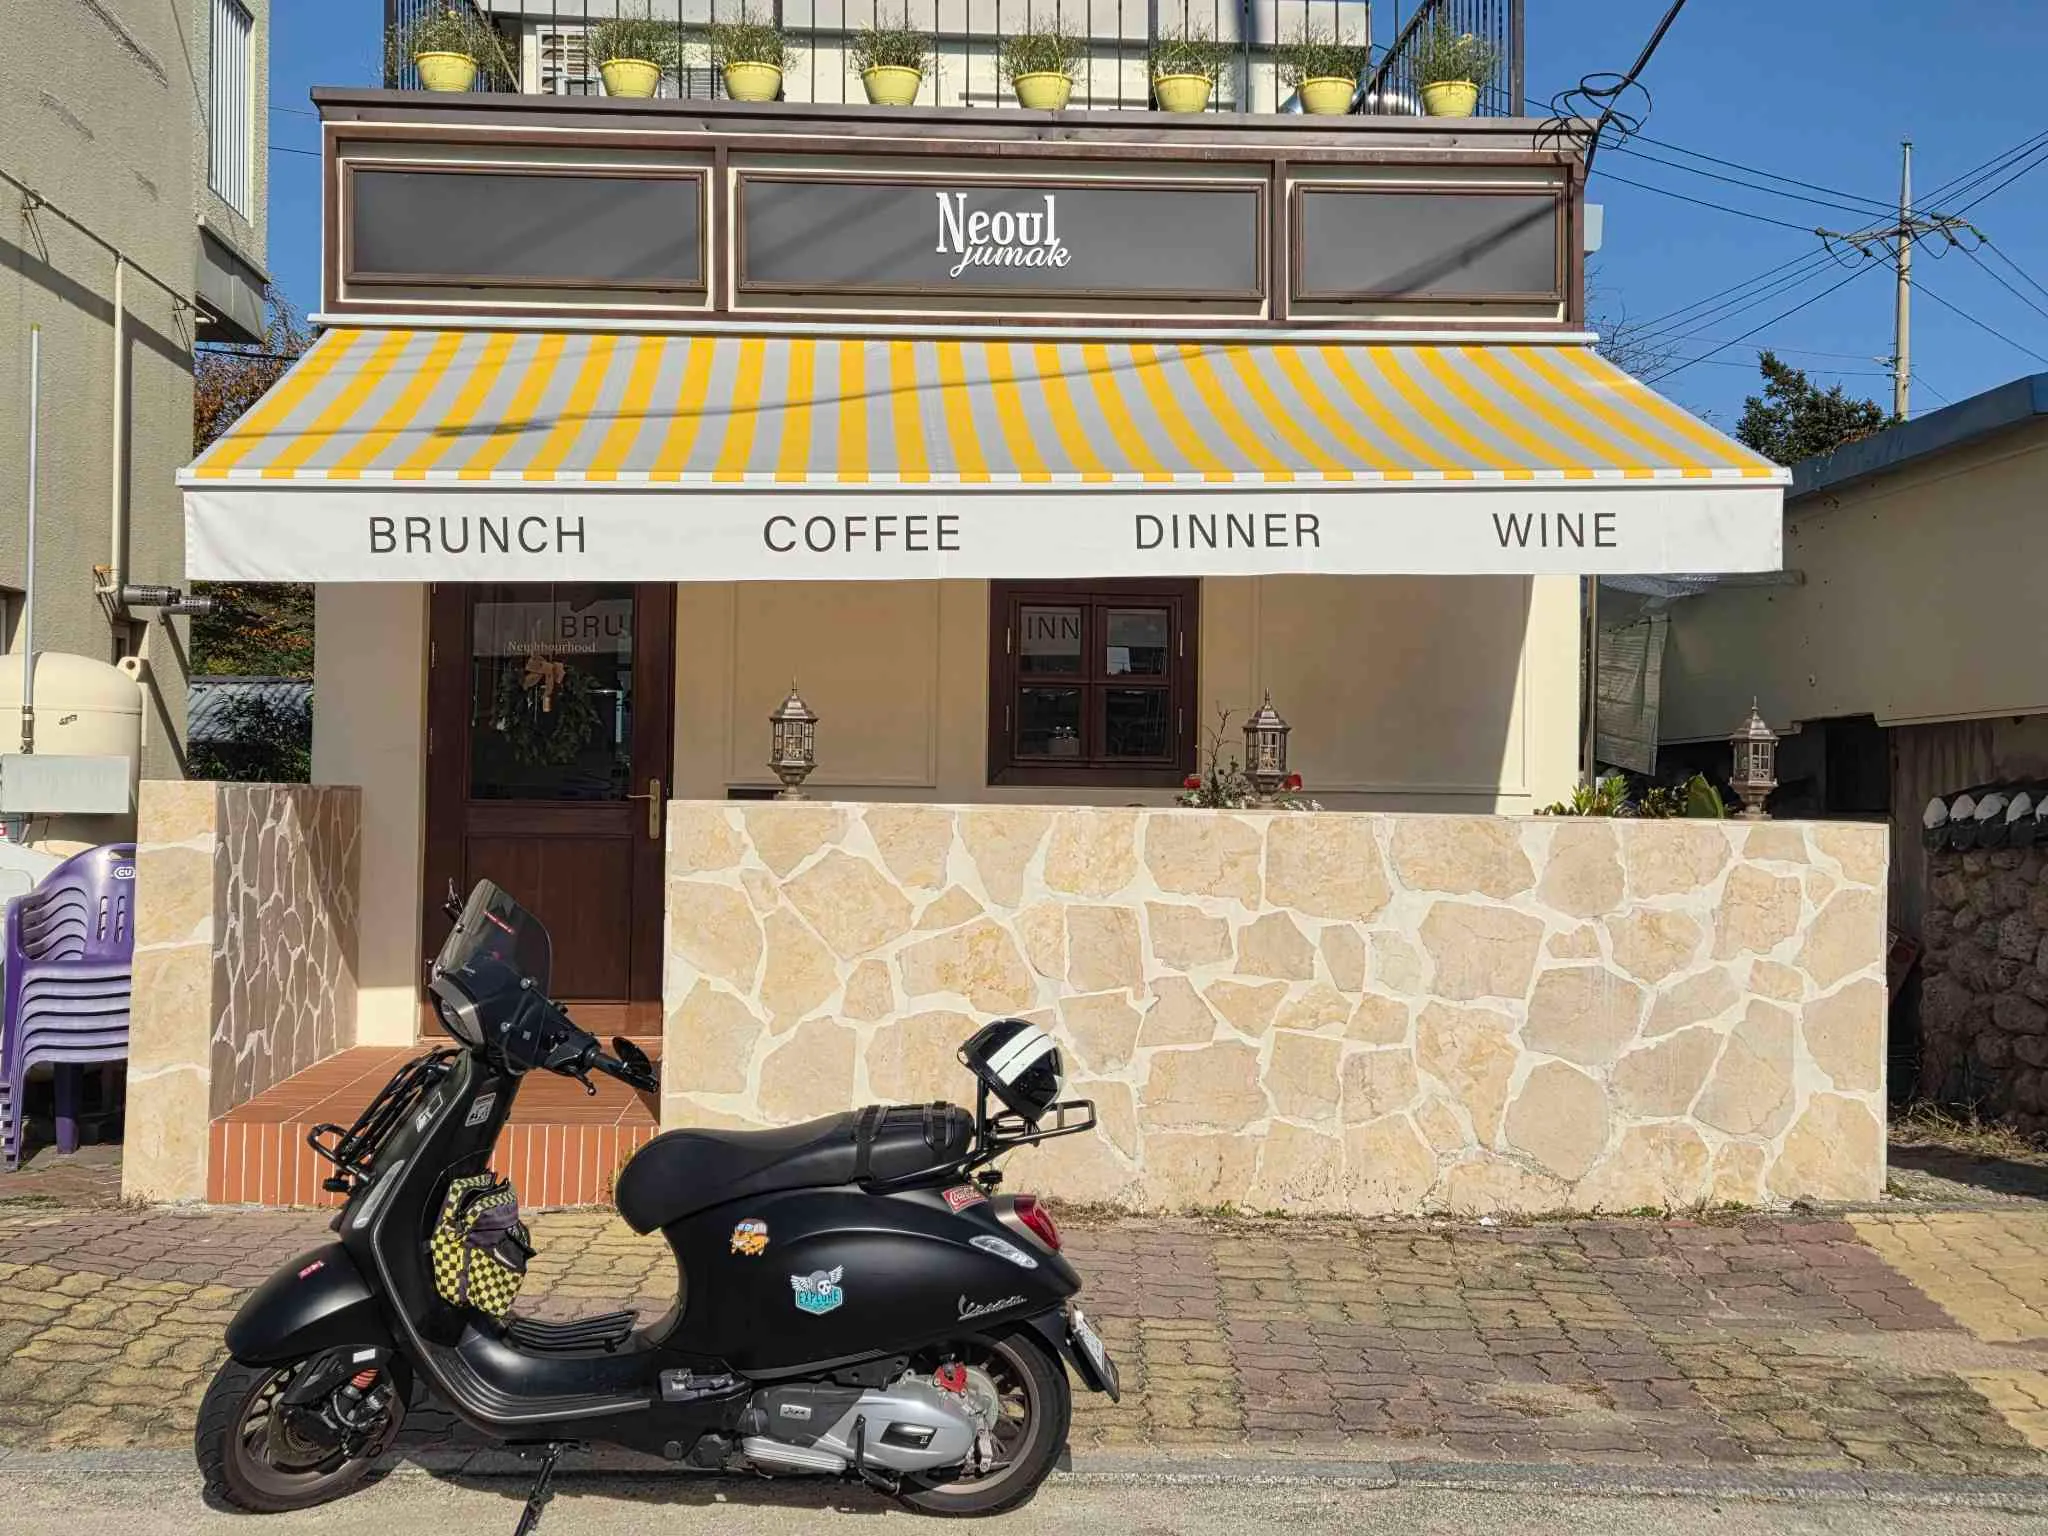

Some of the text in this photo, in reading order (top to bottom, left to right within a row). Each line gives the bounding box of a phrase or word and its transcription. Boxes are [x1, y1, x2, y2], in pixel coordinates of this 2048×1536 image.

[935, 192, 1056, 253] Neoul
[950, 238, 1072, 278] jumak
[370, 513, 1616, 553] BRUNCH COFFEE DINNER WINE
